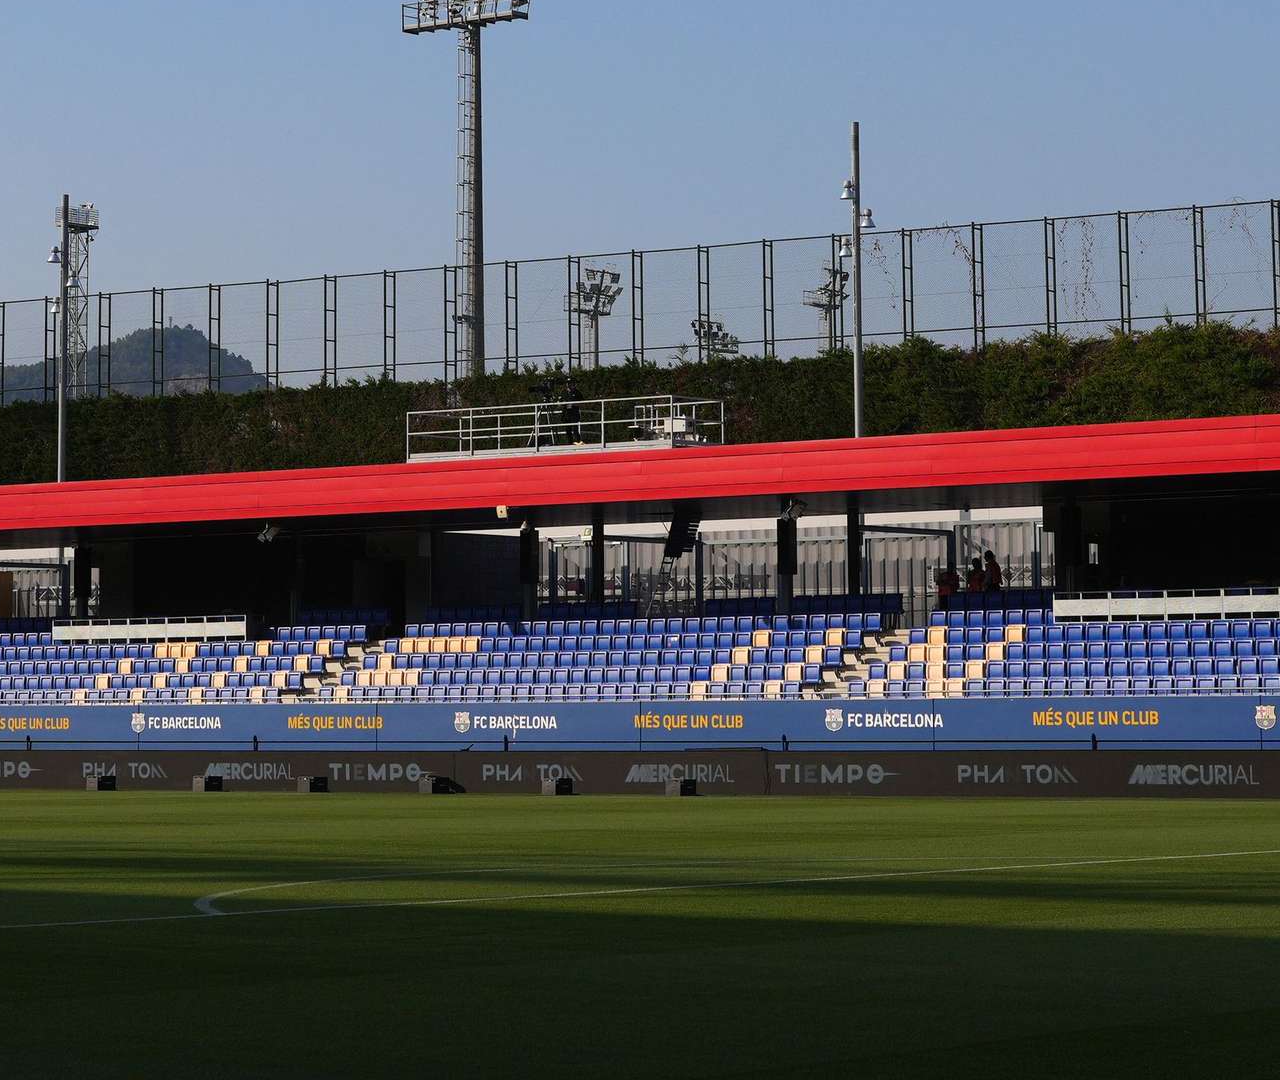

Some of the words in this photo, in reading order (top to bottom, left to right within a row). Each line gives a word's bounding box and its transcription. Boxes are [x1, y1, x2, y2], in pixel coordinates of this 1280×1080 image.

[7, 718, 27, 732] QUE
[29, 718, 43, 729] UN
[45, 718, 70, 729] CLUB
[148, 717, 161, 729] FC
[162, 717, 221, 729] BARCELONA
[287, 713, 311, 729] MÉS
[313, 716, 334, 731] QUE
[337, 716, 352, 729] UN
[354, 716, 383, 729] CLUB
[473, 715, 488, 729] FC
[489, 715, 557, 729] BARCELONA
[634, 711, 664, 728] MÉS
[666, 715, 687, 731] QUE
[691, 715, 708, 728] UN
[712, 715, 743, 728] CLUB
[847, 713, 863, 727] FC
[865, 713, 943, 727] BARCELONA
[1032, 707, 1062, 726] MÉS
[1066, 711, 1095, 729] QUE
[1098, 711, 1119, 726] UN
[1122, 711, 1159, 726] CLUB
[82, 762, 168, 779] PHATOM
[204, 762, 295, 780] MERCURIAL
[328, 762, 432, 782] TIEMPO
[482, 763, 584, 782] PHATOM
[625, 764, 735, 783] MERCURIAL
[774, 763, 901, 784] TIEMPO
[957, 764, 1078, 784] PHATOM
[1129, 764, 1260, 785] MERCURIAL
